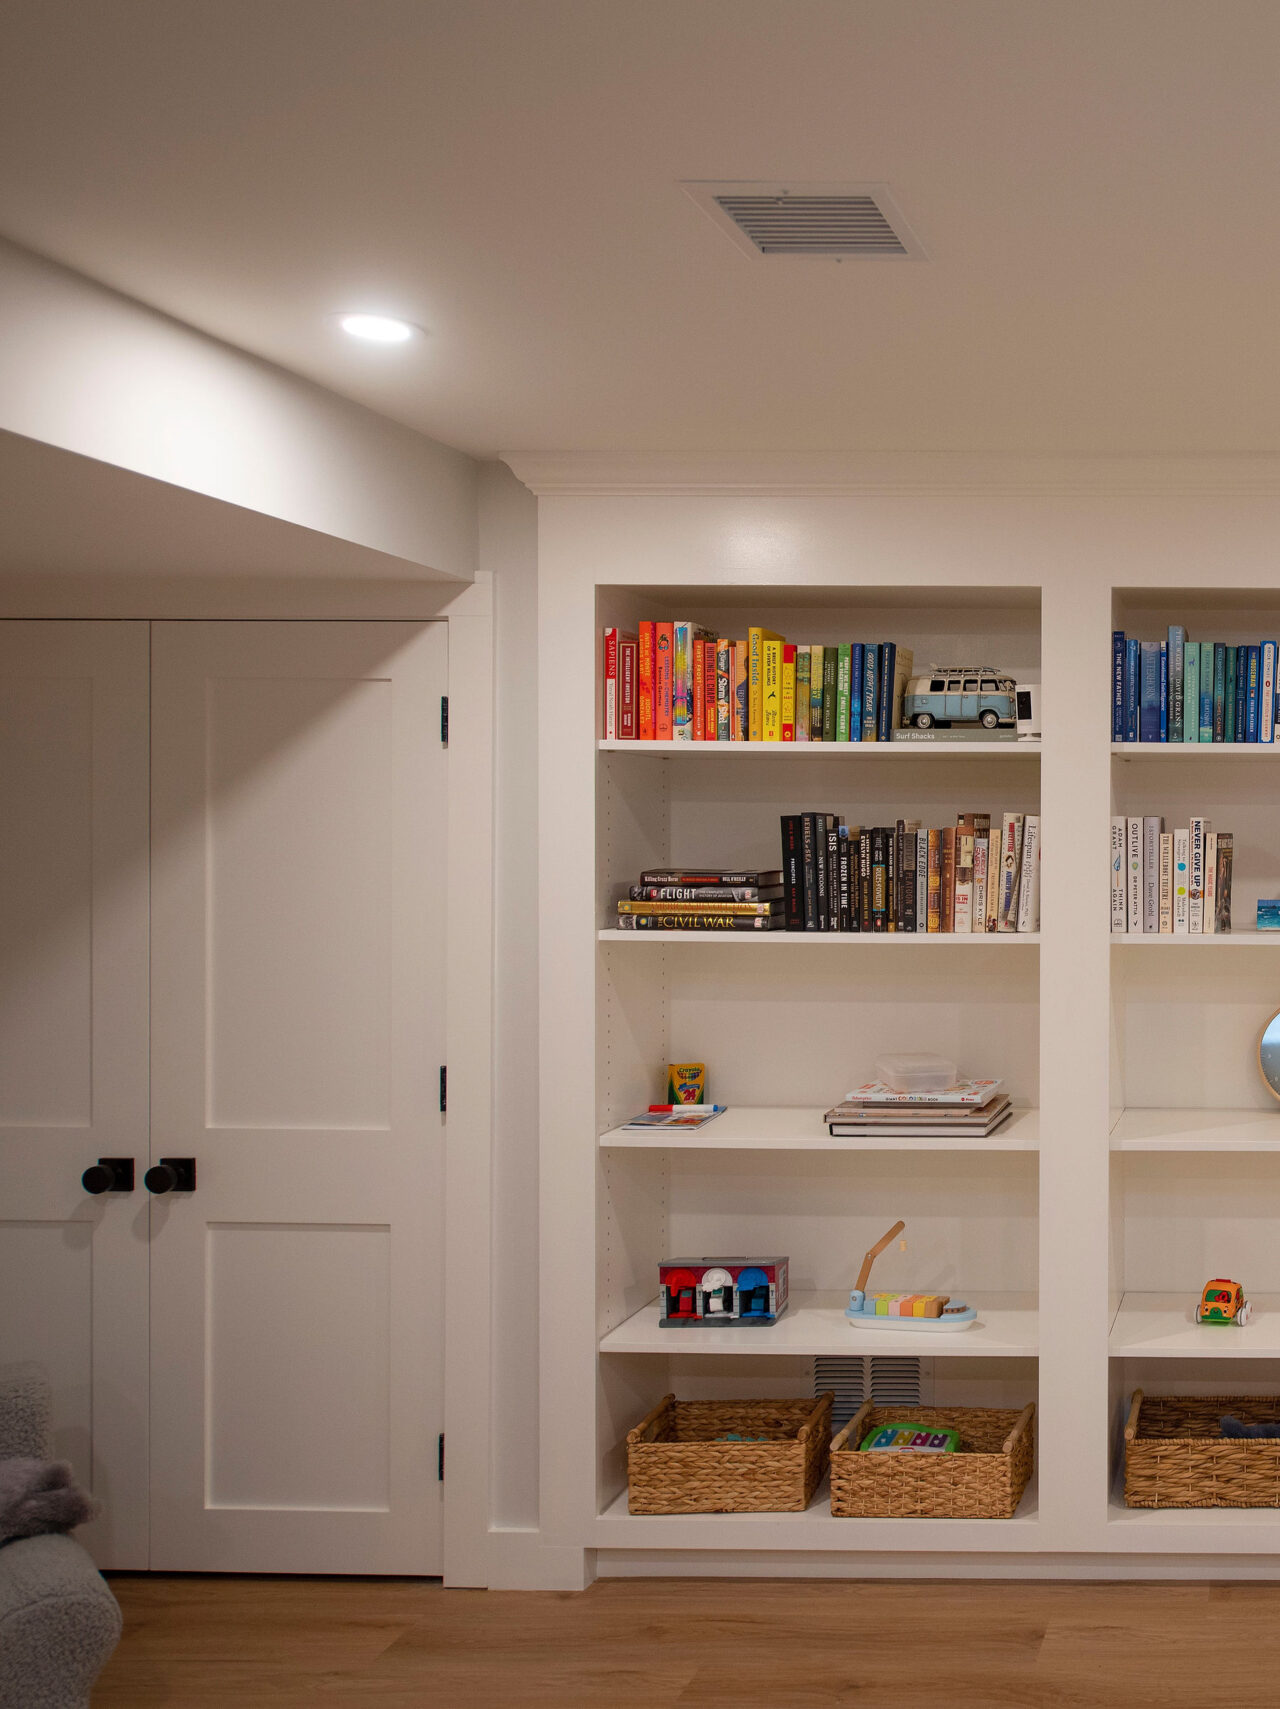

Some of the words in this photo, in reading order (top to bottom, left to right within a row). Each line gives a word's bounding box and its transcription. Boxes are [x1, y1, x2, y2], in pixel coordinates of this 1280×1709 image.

[751, 633, 760, 657] Good
[608, 641, 617, 677] SAPIENS
[706, 646, 716, 673] HUNTING
[866, 652, 875, 670] GOOD
[706, 674, 716, 682] EL
[751, 658, 760, 686] Inside
[706, 683, 716, 704] CHAPO
[718, 678, 728, 699] Storm
[866, 691, 875, 713] IRENE
[896, 732, 911, 740] Surf
[911, 732, 935, 740] Shacks
[828, 833, 838, 852] ISIS
[918, 837, 927, 858] BLACK
[1025, 825, 1037, 859] Lifespan
[1131, 823, 1139, 859] OUTLIVE
[1161, 835, 1170, 846] THE
[905, 839, 914, 870] OUTLAW
[1161, 847, 1170, 877] WHALEBONE
[840, 857, 848, 882] FROZEN
[918, 860, 927, 879] EDGE
[840, 883, 848, 891] IN
[905, 871, 914, 905] PLATOON
[1005, 870, 1013, 891] ANDREW
[1161, 878, 1170, 901] THEATRE
[1194, 874, 1201, 888] UP
[660, 888, 697, 900] FLIGHT
[840, 893, 848, 909] TIME
[1147, 899, 1155, 917] Grohl
[664, 917, 701, 928] CIVIL
[706, 917, 736, 928] WAR
[683, 1088, 698, 1102] 24
